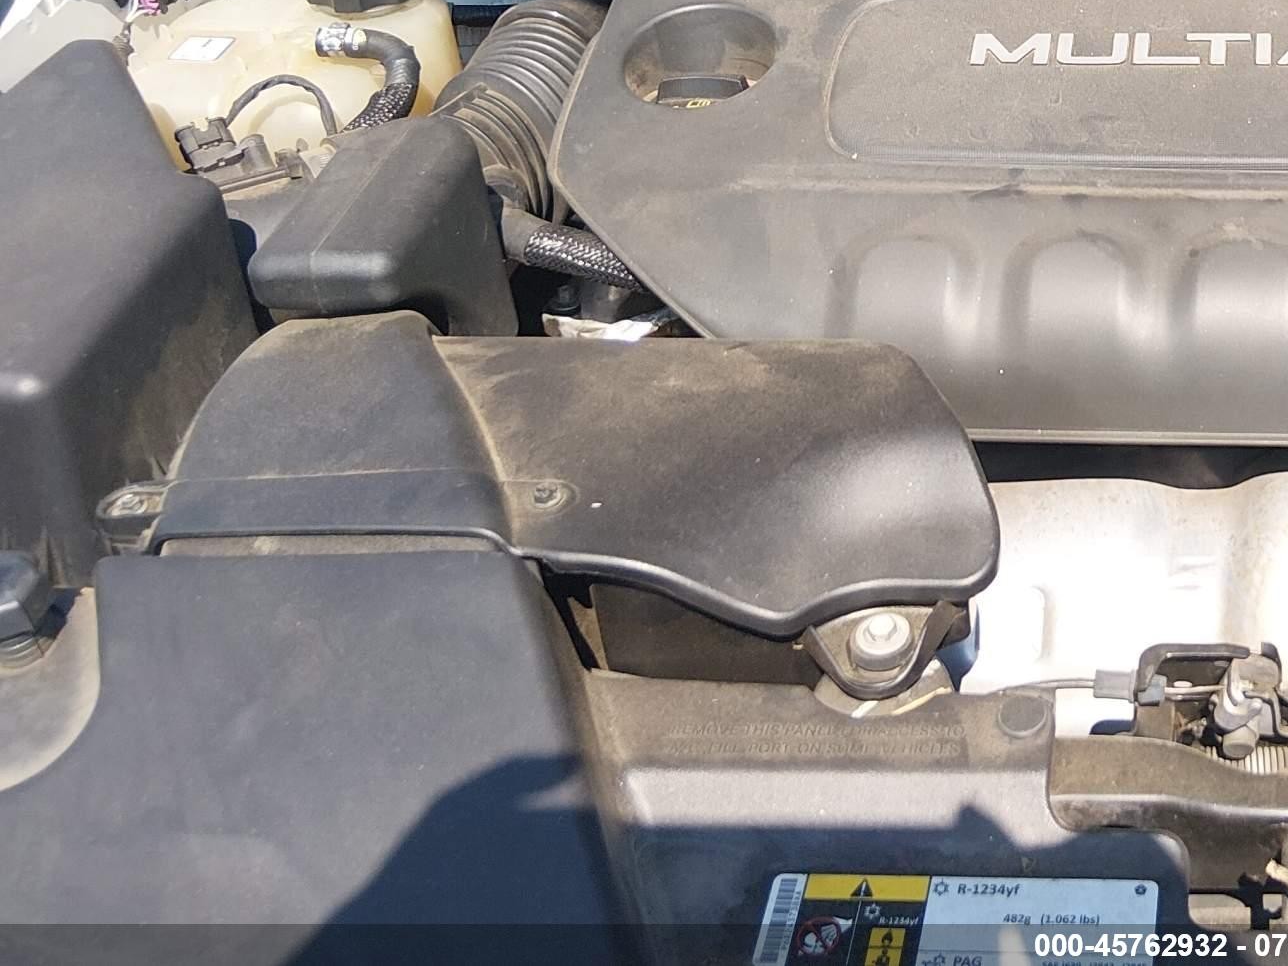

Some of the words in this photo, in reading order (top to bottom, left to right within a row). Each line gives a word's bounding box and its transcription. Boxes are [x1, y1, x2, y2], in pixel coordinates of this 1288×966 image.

[748, 741, 792, 754] PORT
[798, 741, 824, 754] ON
[956, 883, 1020, 897] R-1234yf
[1002, 913, 1032, 925] 482g
[1040, 913, 1077, 925] (1.062
[1079, 913, 1101, 925] lbs)
